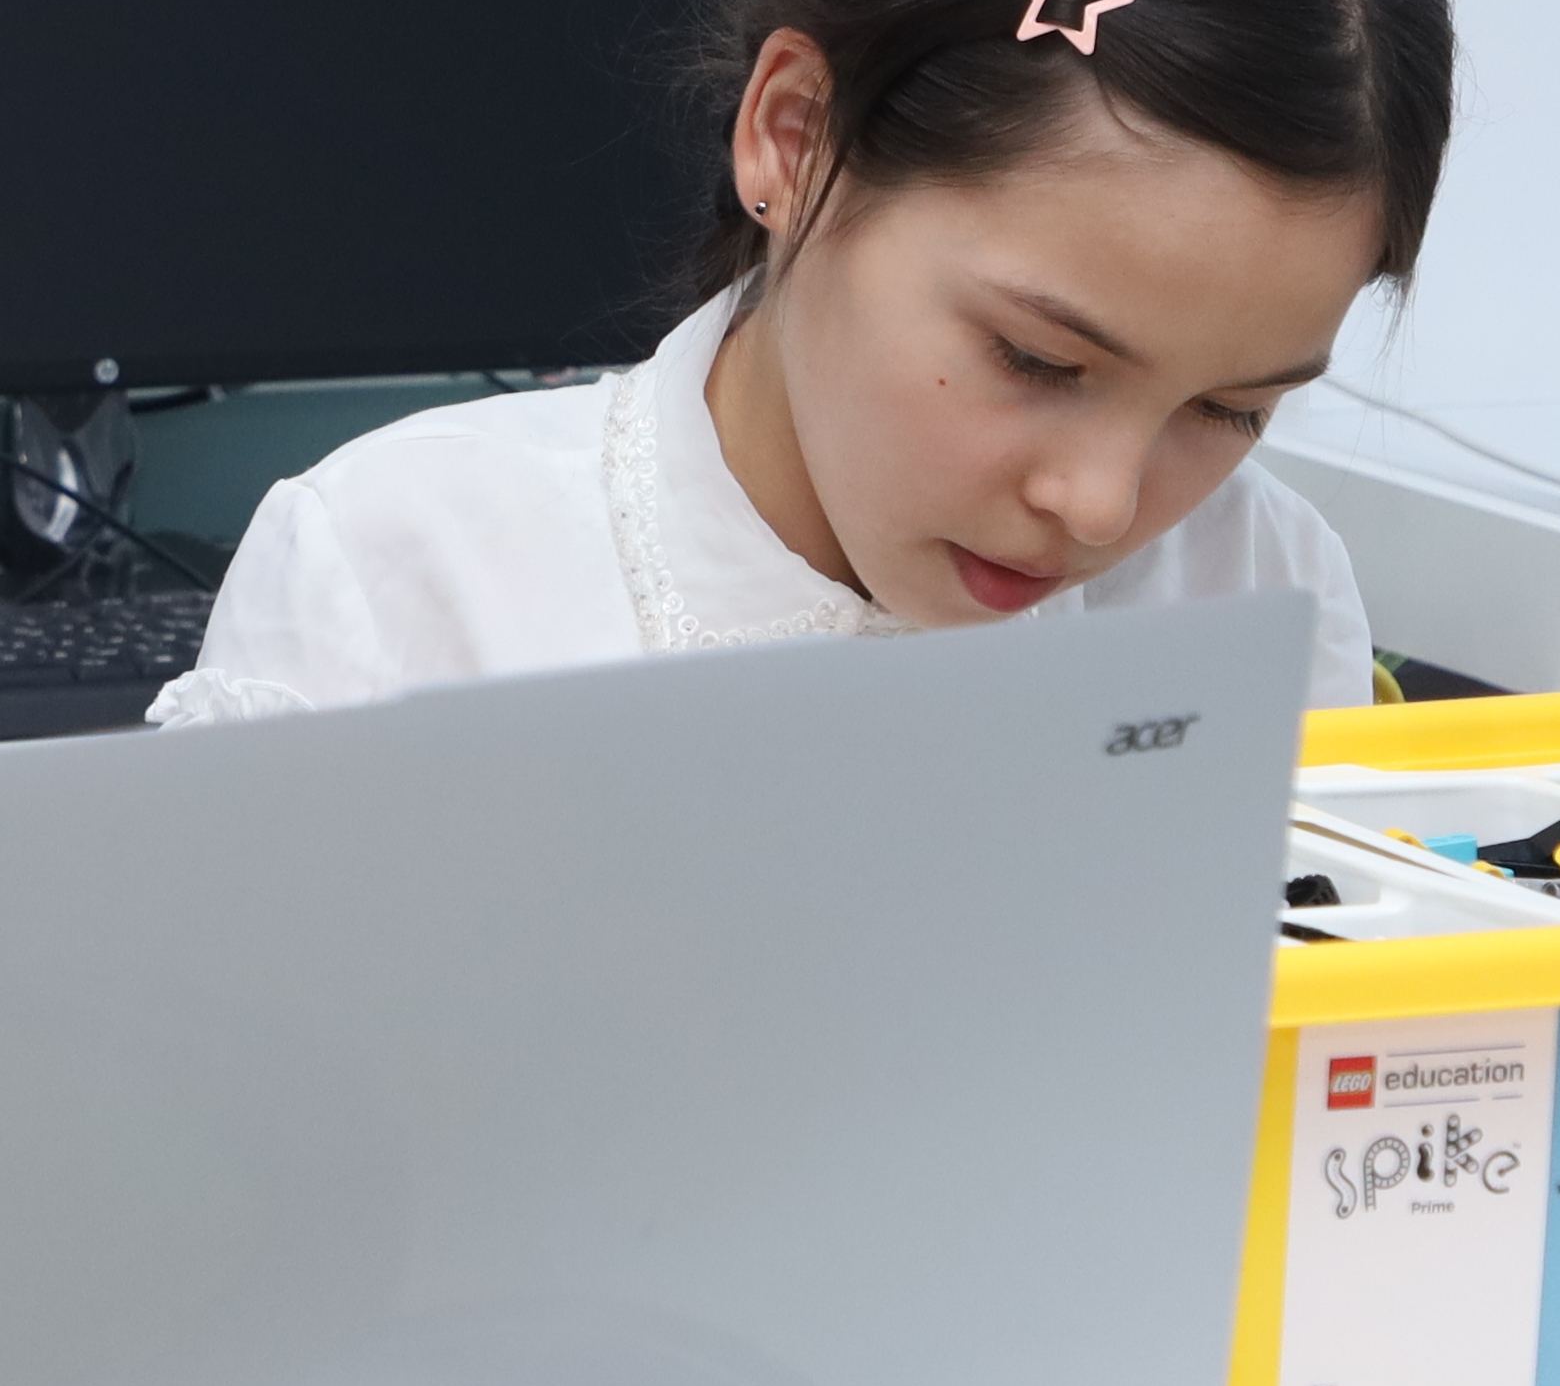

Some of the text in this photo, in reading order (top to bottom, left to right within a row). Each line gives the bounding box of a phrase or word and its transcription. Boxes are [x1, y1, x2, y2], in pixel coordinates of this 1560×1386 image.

[1105, 711, 1201, 756] acer
[1332, 1058, 1525, 1093] LEGO education
[1411, 1201, 1455, 1214] Prime
